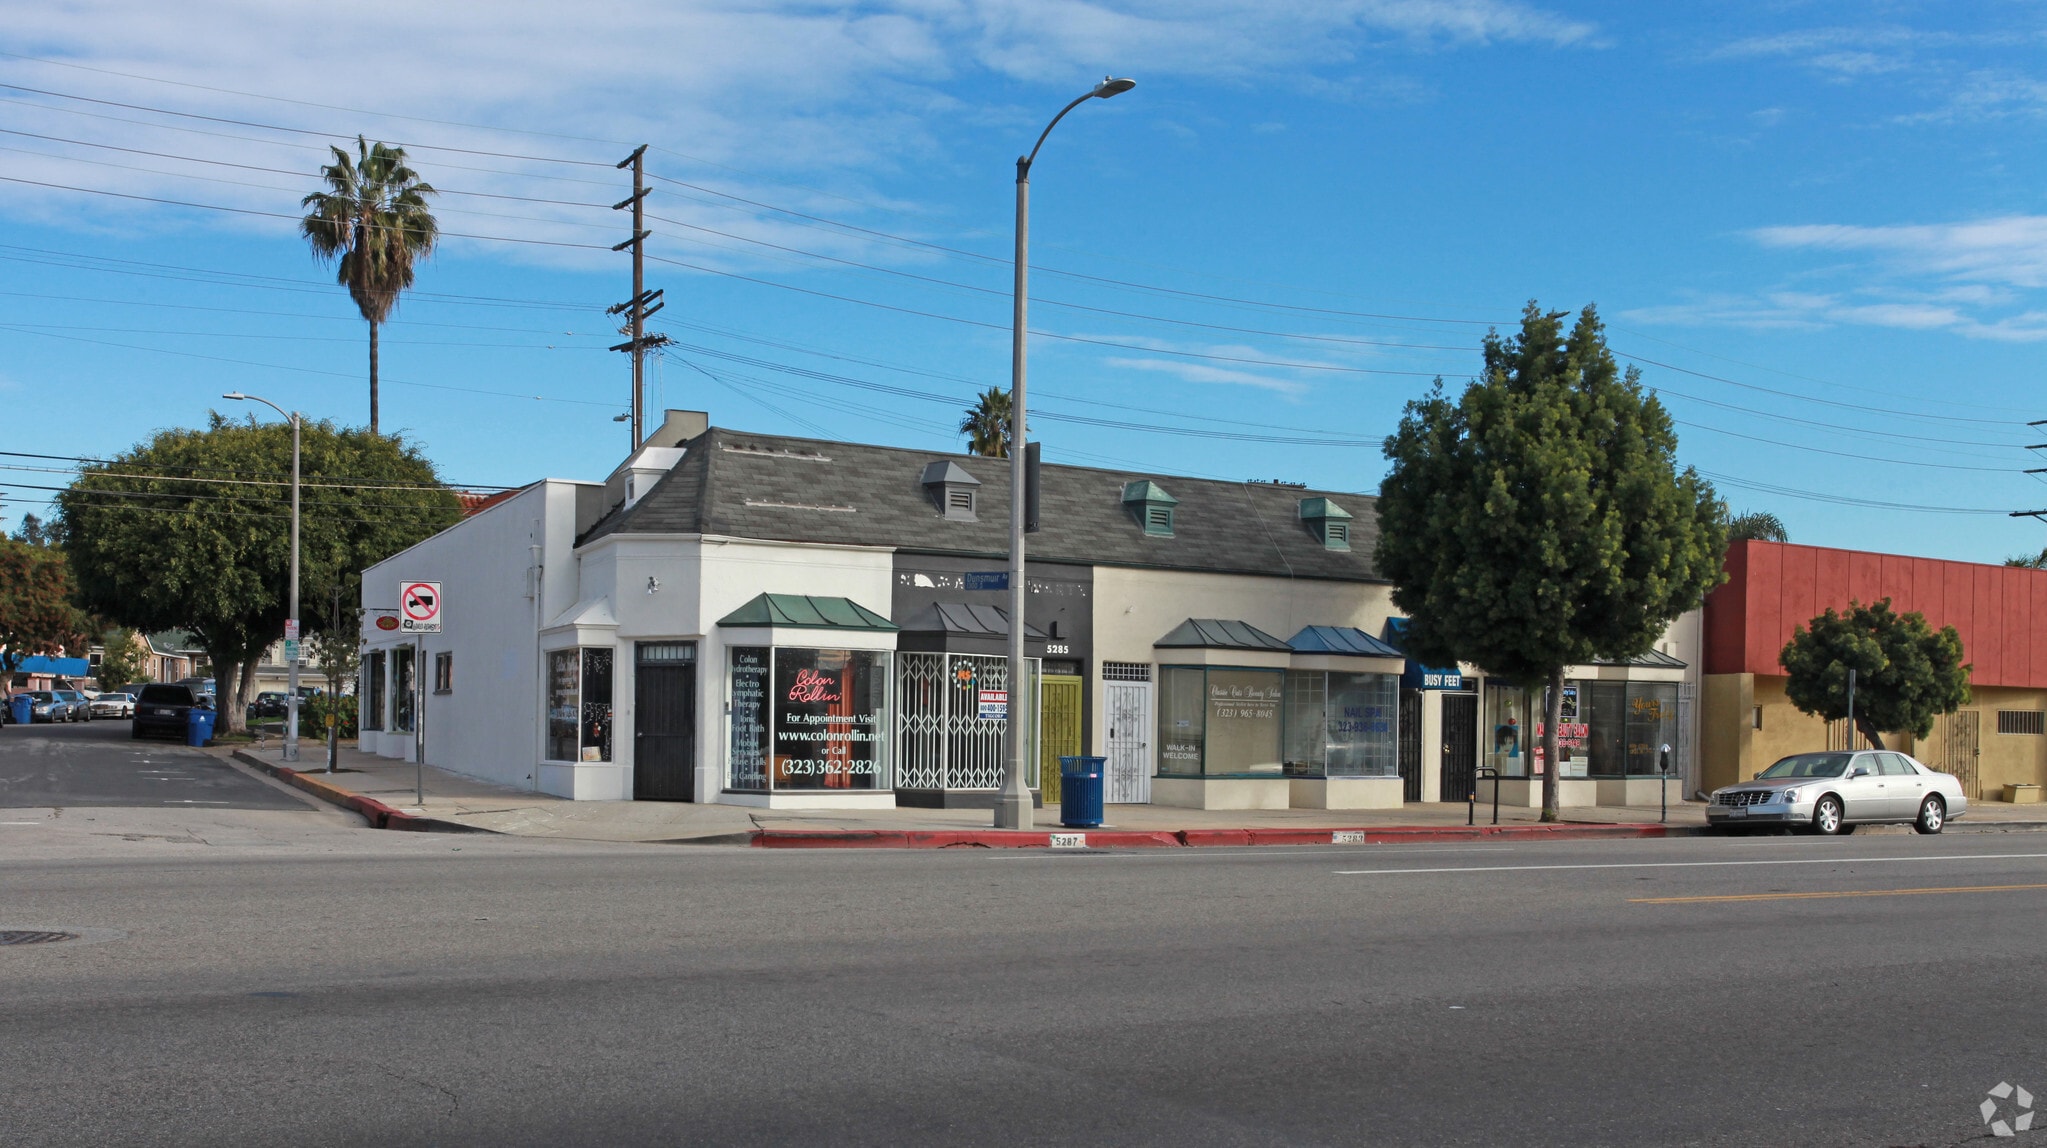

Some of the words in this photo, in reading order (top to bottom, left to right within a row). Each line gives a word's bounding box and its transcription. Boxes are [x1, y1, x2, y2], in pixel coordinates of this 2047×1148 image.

[966, 573, 1000, 582] Dunsmuir
[1046, 644, 1068, 654] 5285
[740, 655, 758, 663] Colon
[796, 669, 835, 686] Colon
[1424, 674, 1442, 686] BUSY
[1444, 675, 1460, 686] FEET
[736, 679, 760, 688] Electro
[1209, 684, 1228, 698] Classic
[1244, 685, 1264, 700] Beauty
[734, 701, 760, 711] Therapy
[1632, 696, 1660, 716] Yours
[1217, 708, 1237, 718] (323)
[1344, 707, 1363, 718] NAIL
[1365, 707, 1382, 718] SPA
[786, 713, 801, 722] For
[803, 713, 856, 725] Appointment
[859, 714, 876, 723] Visit
[732, 724, 747, 733] Foot
[749, 724, 765, 733] Bath
[1558, 723, 1572, 737] EAUTY
[1574, 723, 1588, 737] SALON
[778, 729, 885, 741] www.colonrollin.net
[832, 746, 846, 755] Call
[1163, 752, 1199, 760] WELCOME
[750, 757, 766, 766] Calls
[1056, 837, 1078, 846] 5287
